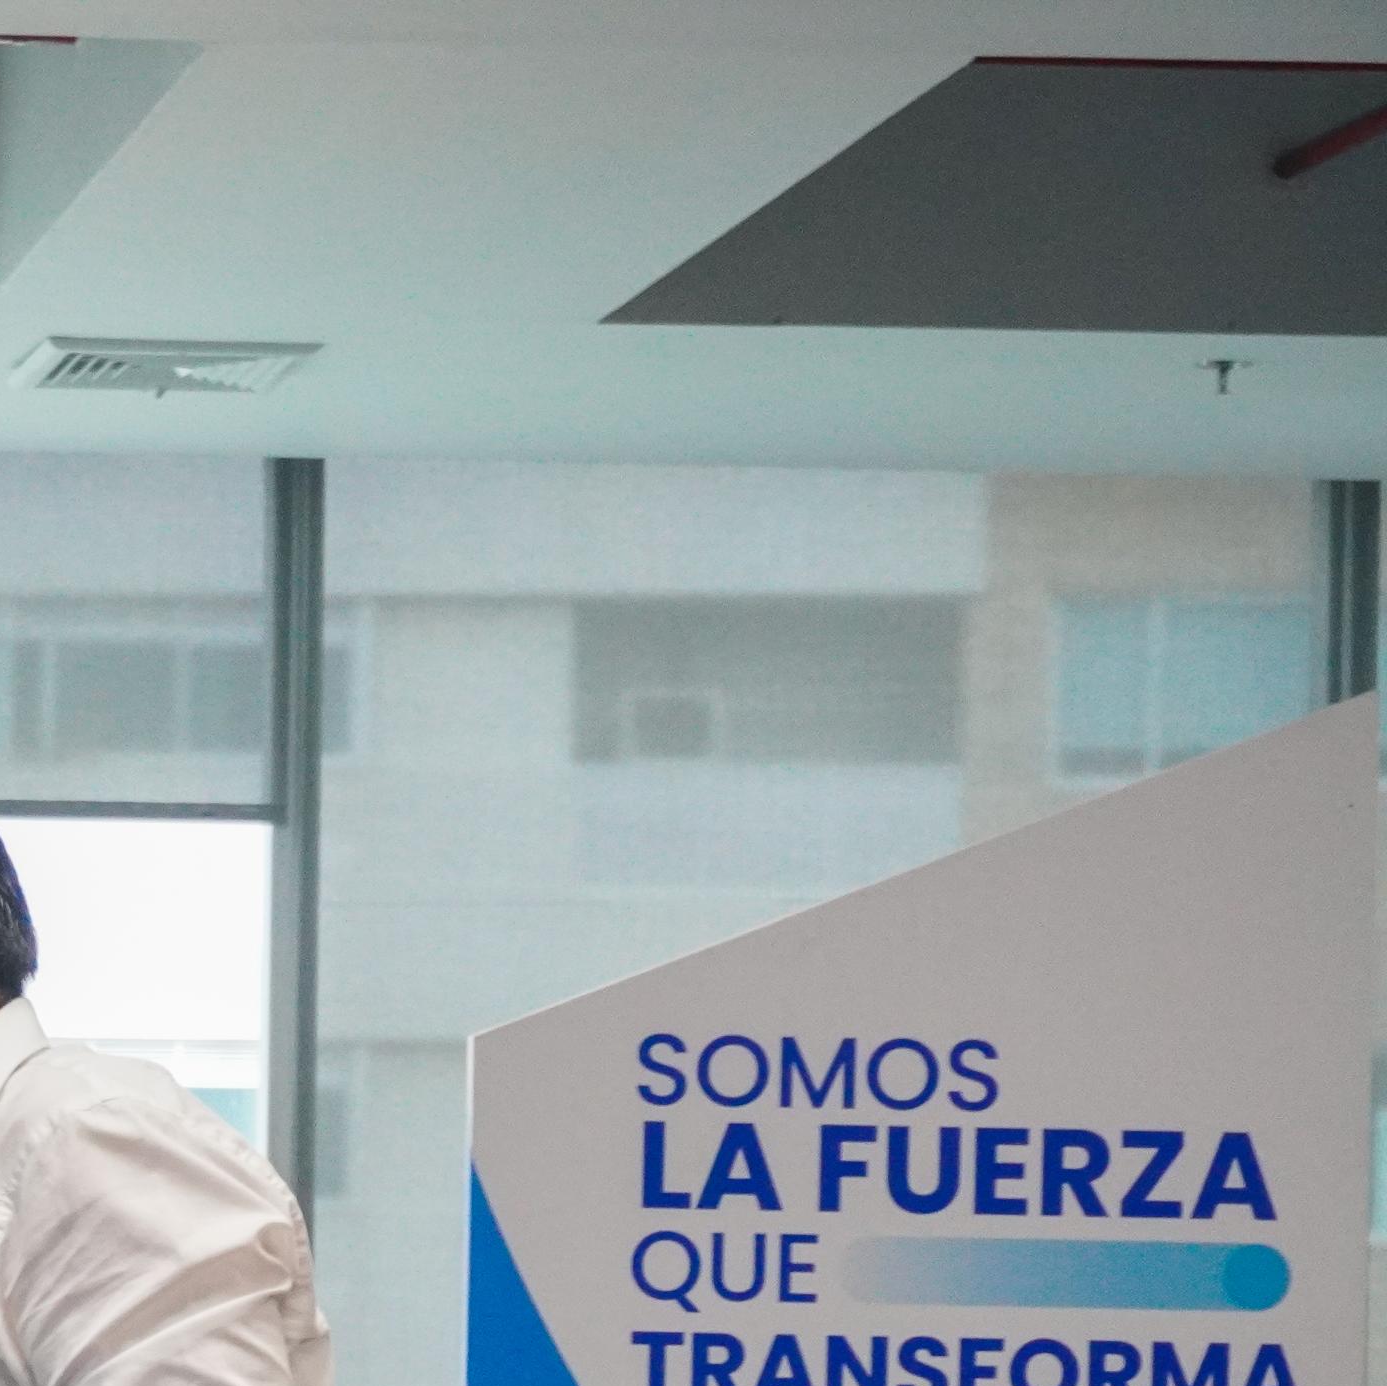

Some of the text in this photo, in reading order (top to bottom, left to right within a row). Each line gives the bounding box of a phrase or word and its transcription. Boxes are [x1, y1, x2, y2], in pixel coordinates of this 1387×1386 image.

[636, 1033, 1000, 1113] SOMOS
[641, 1120, 1277, 1222] LA FUERZA
[630, 1229, 820, 1314] QUE
